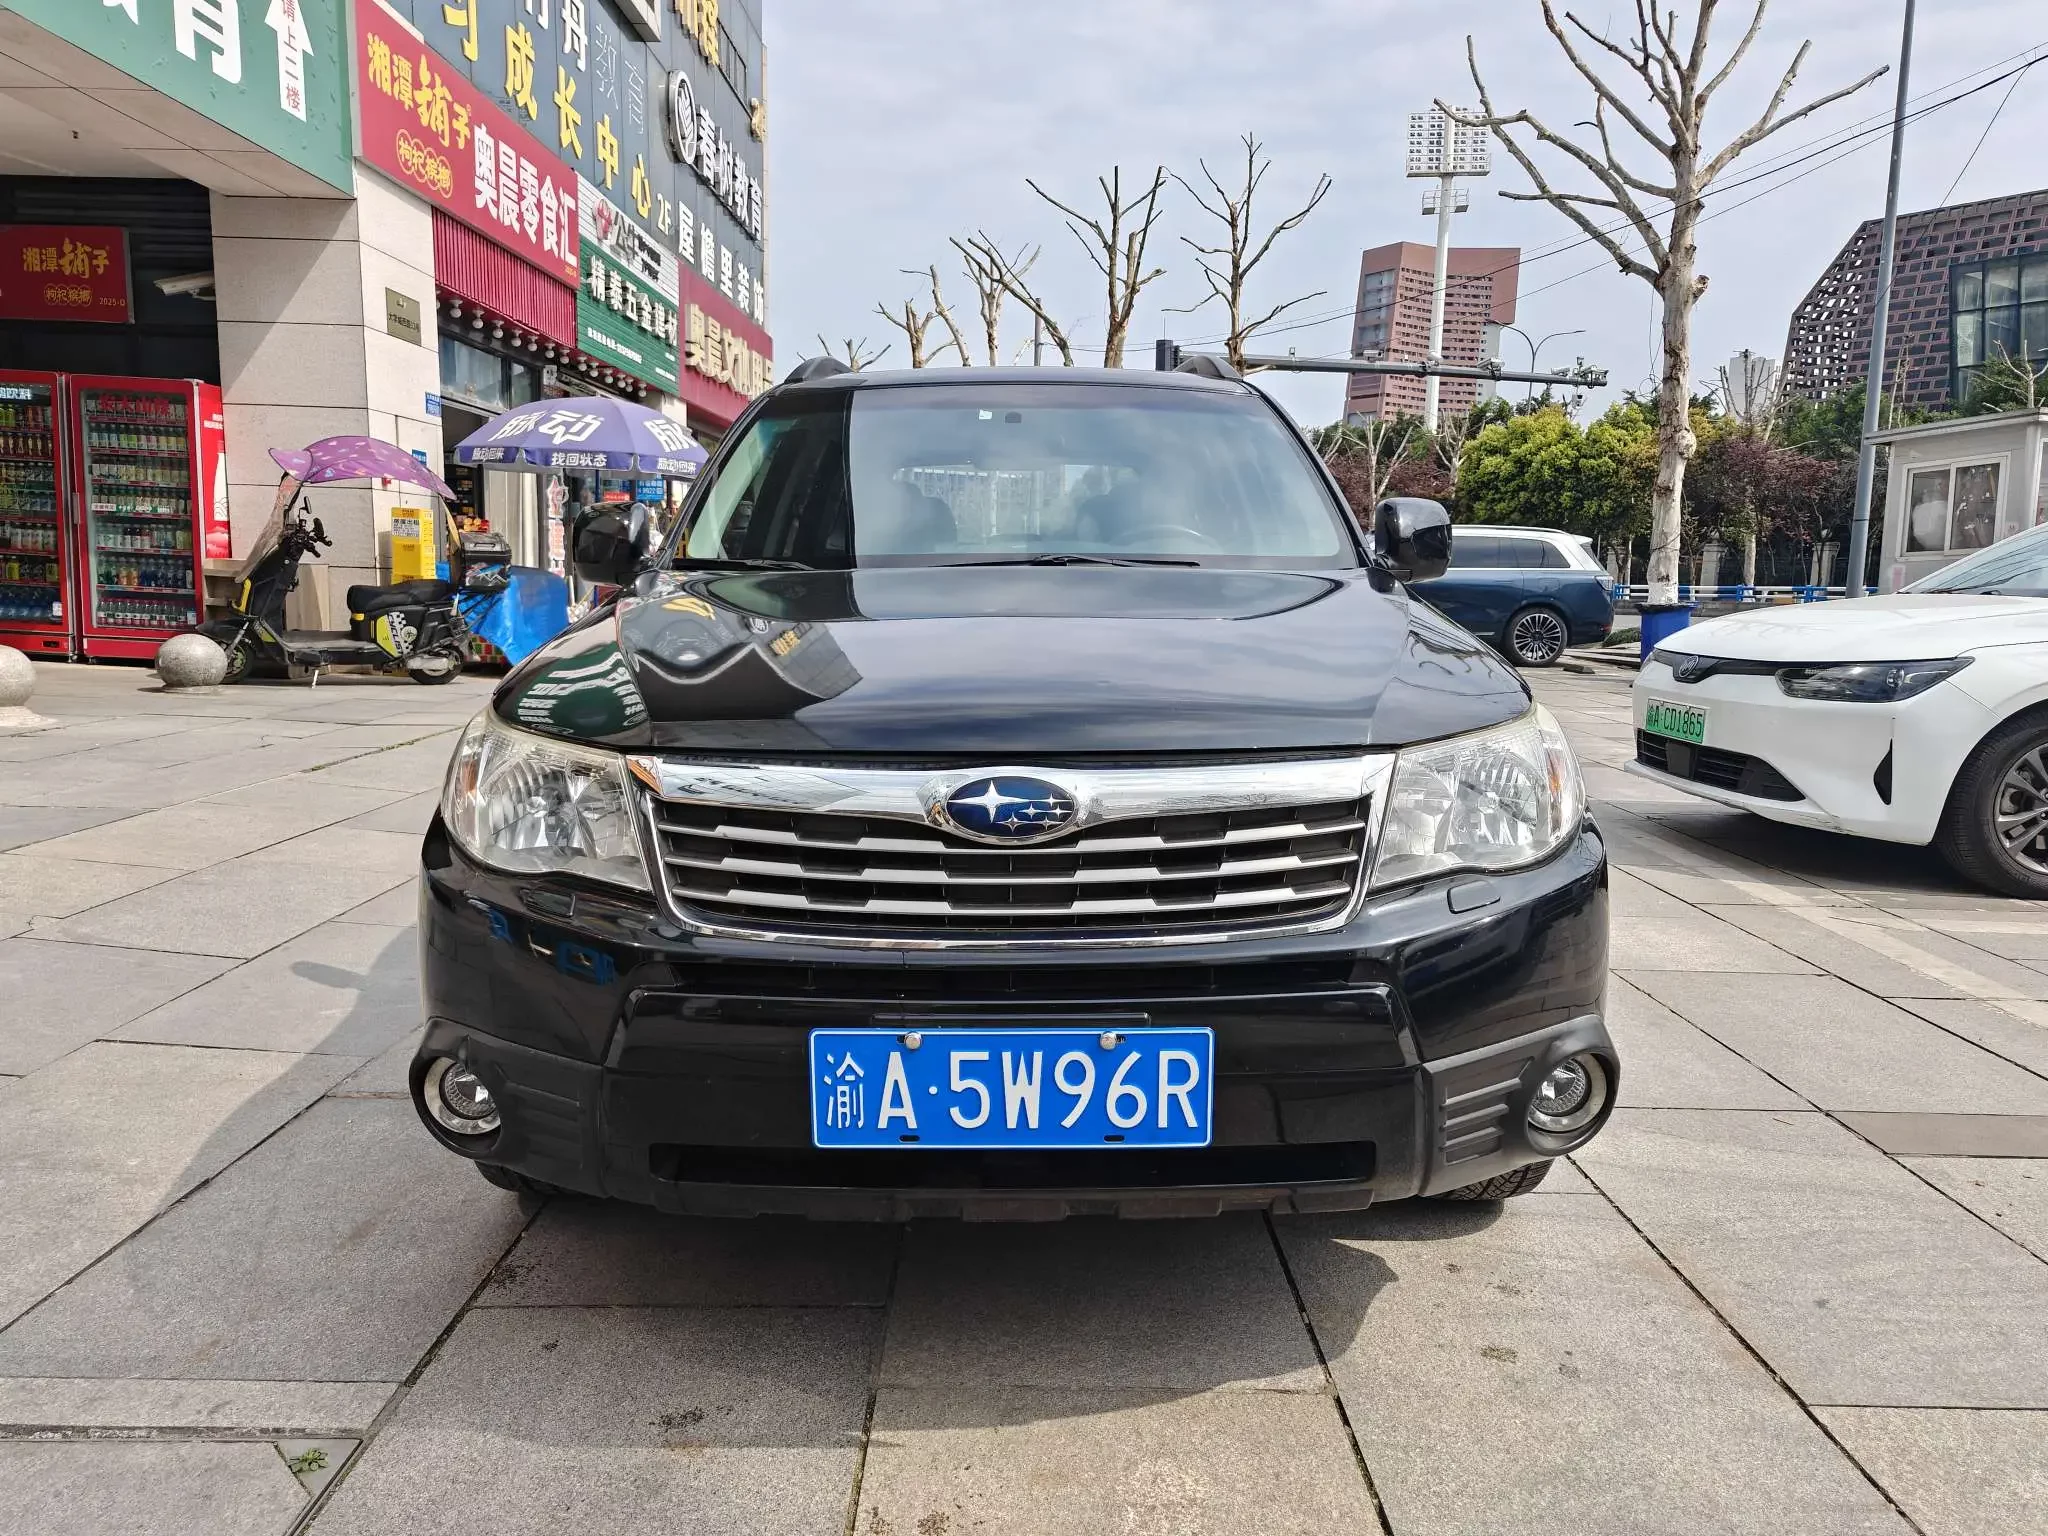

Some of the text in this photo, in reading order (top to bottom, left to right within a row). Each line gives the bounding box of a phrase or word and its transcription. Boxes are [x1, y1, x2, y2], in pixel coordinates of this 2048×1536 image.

[367, 32, 471, 150] 湘潭铺子
[698, 104, 763, 242] 春树教育
[473, 123, 578, 268] 奥晨零食汇
[22, 236, 110, 279] 湘潭铺子
[488, 410, 605, 445] 脉动
[551, 453, 608, 467] 找回状态
[656, 457, 697, 474] 脉动回来
